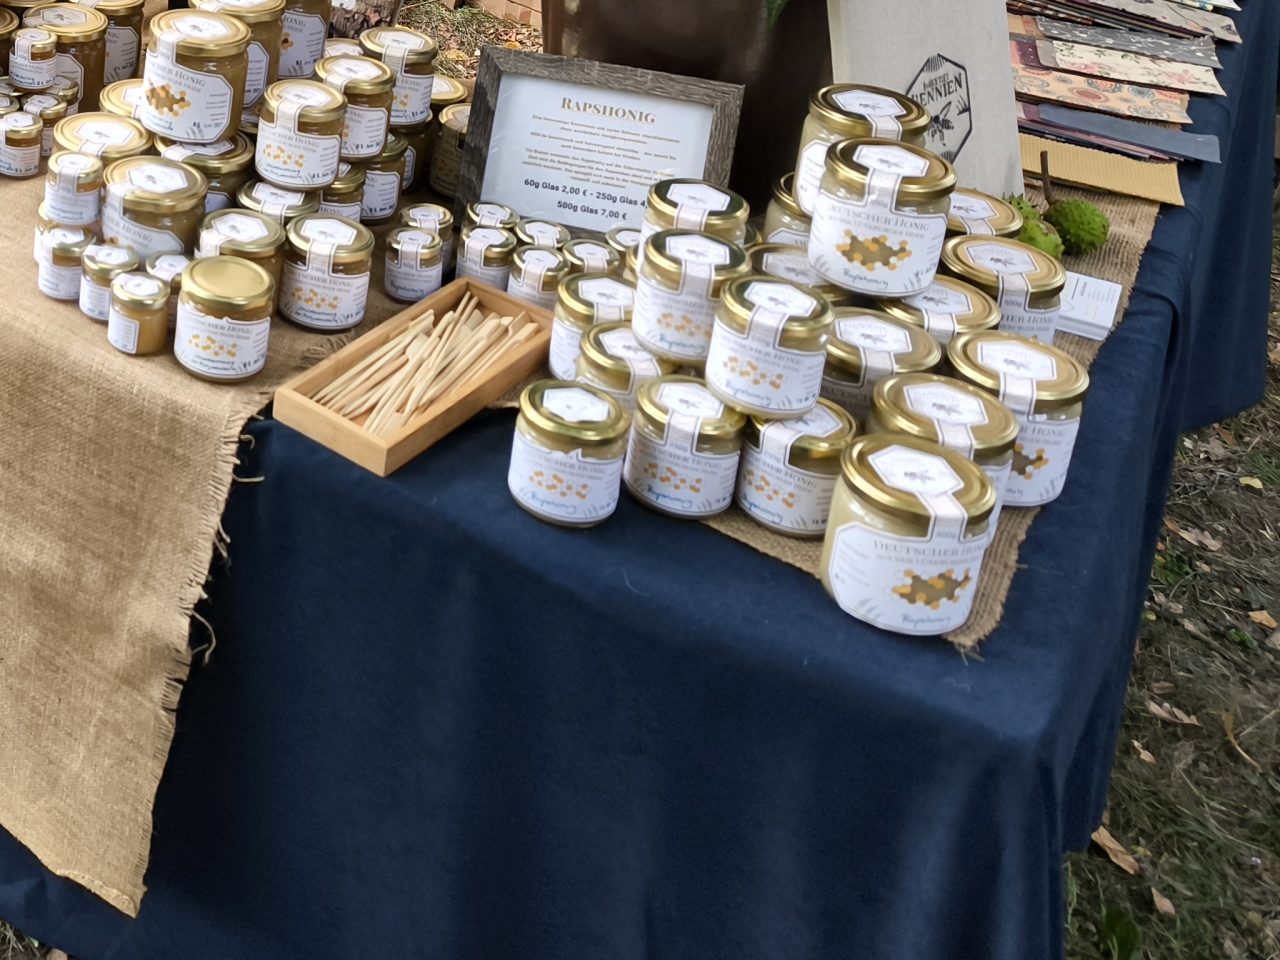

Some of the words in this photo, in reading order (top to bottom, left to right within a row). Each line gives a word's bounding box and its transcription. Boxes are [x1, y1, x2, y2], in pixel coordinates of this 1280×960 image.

[561, 97, 656, 124] RAPSHONIG
[524, 178, 540, 189] 60g
[541, 181, 560, 192] Glas
[561, 185, 580, 196] 2,00
[582, 189, 588, 197] €
[596, 191, 618, 204] 250g
[619, 195, 638, 206] Glas
[640, 199, 648, 208] 4,
[557, 201, 579, 212] 500g
[580, 205, 599, 215] Glas
[600, 208, 620, 219] 7,00
[622, 212, 628, 220] €
[894, 218, 929, 232] HONIG
[874, 540, 959, 557] DEUTSCHER
